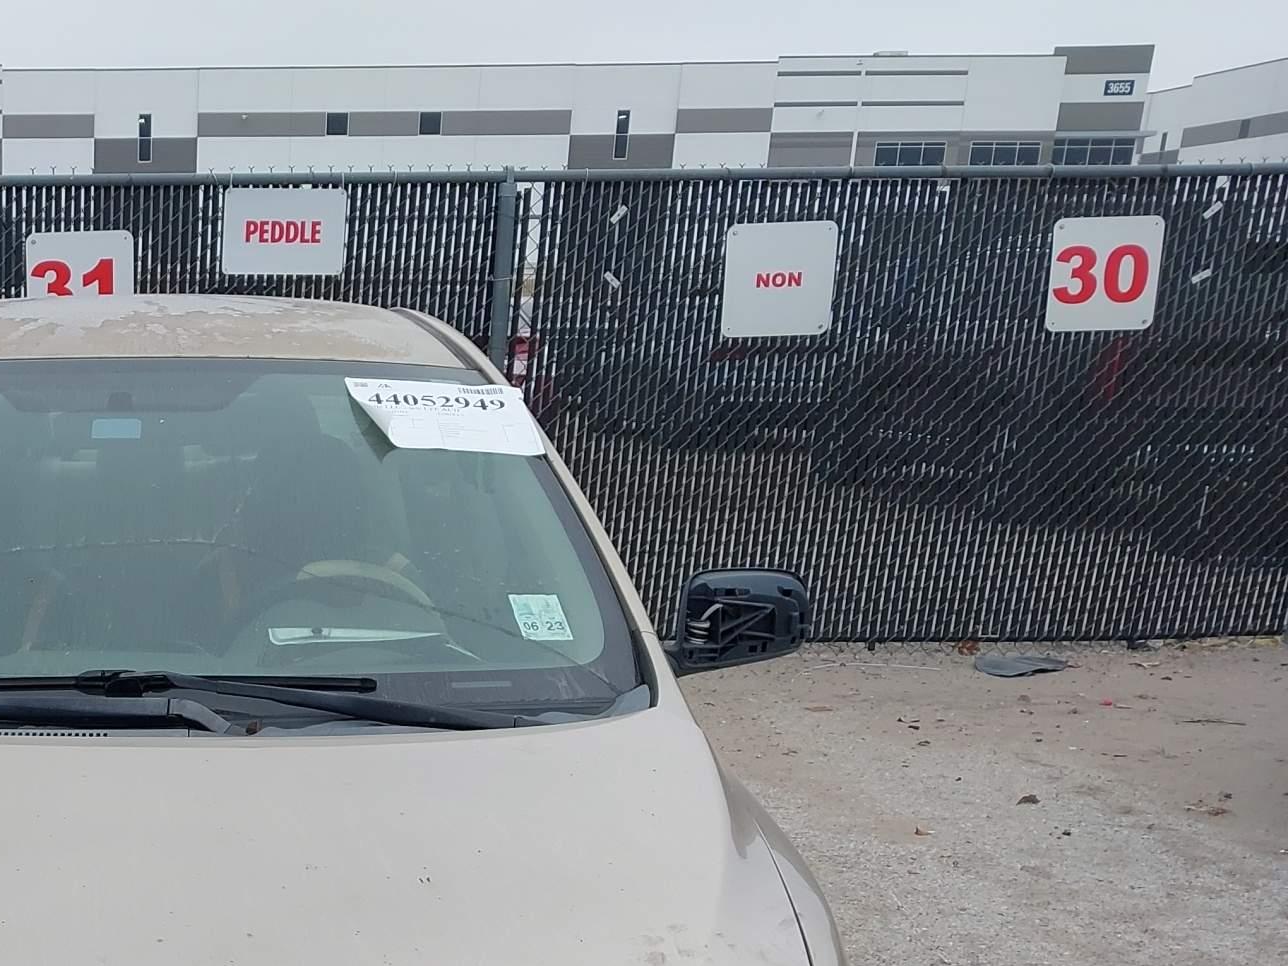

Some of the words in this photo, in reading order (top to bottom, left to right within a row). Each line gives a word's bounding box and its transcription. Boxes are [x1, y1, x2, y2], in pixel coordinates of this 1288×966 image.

[1106, 82, 1132, 94] 3655
[245, 221, 323, 245] PEDDLE
[30, 258, 115, 297] 31
[755, 272, 803, 289] NON
[1052, 244, 1150, 305] 30
[368, 392, 505, 410] 44052949
[523, 621, 539, 631] 06
[545, 620, 565, 631] 23
